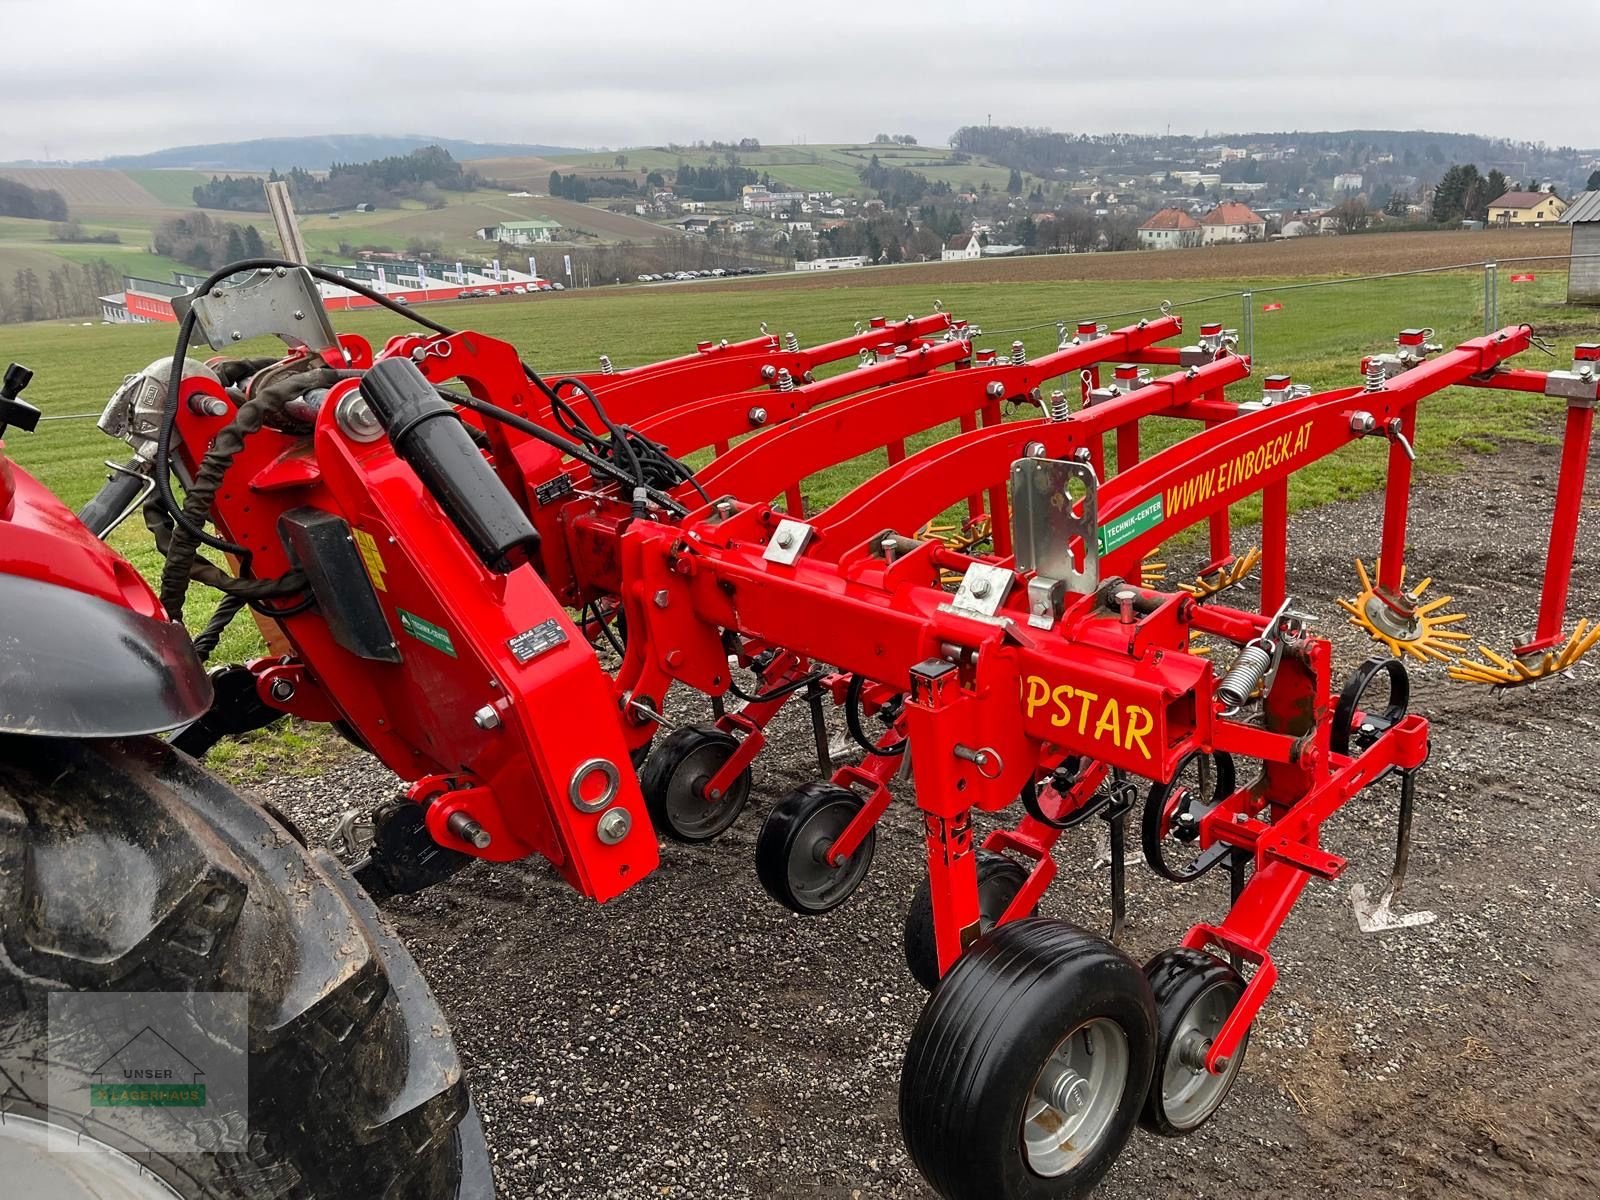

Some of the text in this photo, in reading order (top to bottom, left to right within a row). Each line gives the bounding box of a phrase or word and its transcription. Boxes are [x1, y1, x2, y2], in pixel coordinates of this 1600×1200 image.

[1166, 420, 1313, 518] WWW.EINBOECK.AT
[1107, 501, 1161, 538] TECHNIK-CENTER
[1020, 675, 1154, 760] PSTAR
